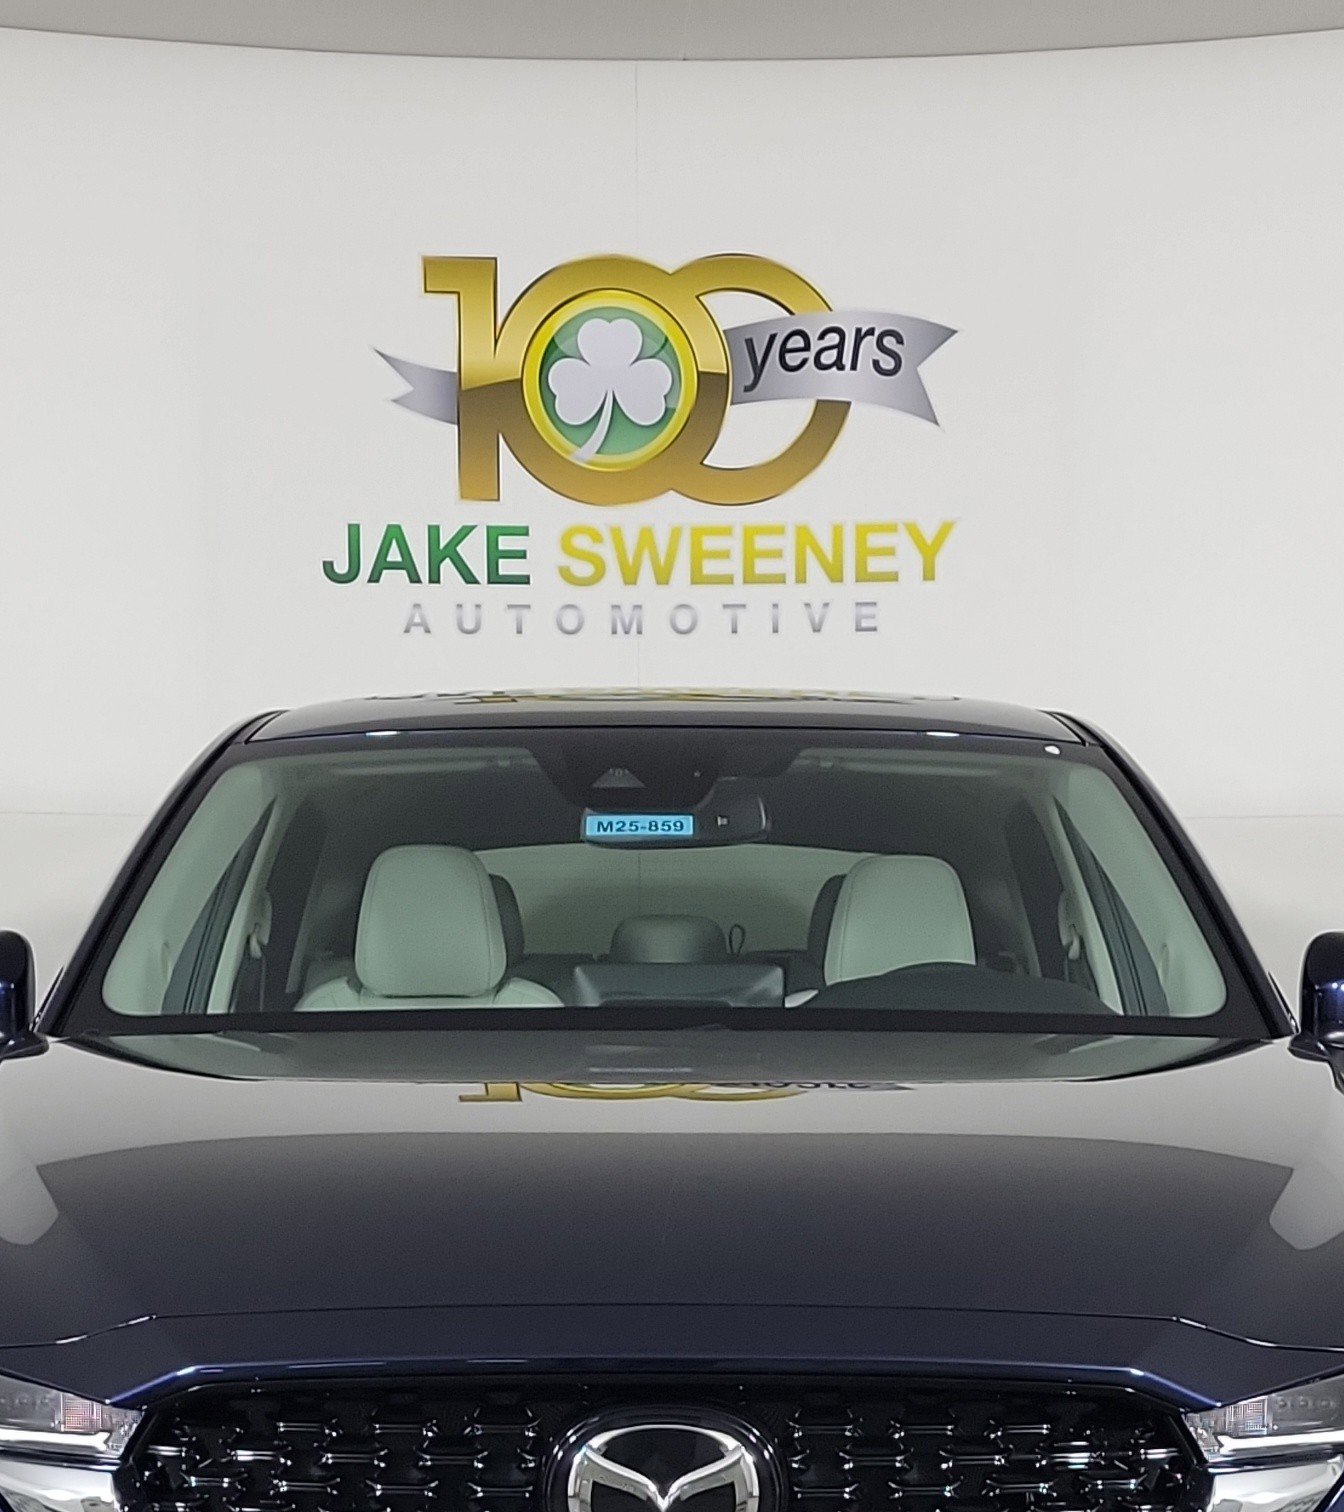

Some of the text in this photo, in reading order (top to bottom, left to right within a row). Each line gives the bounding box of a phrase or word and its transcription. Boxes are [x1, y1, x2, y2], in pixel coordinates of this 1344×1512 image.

[743, 325, 904, 393] years
[323, 521, 955, 586] JAKE SWEENEY
[404, 602, 878, 635] AUTOMOTIVE
[597, 820, 684, 833] M25-859
